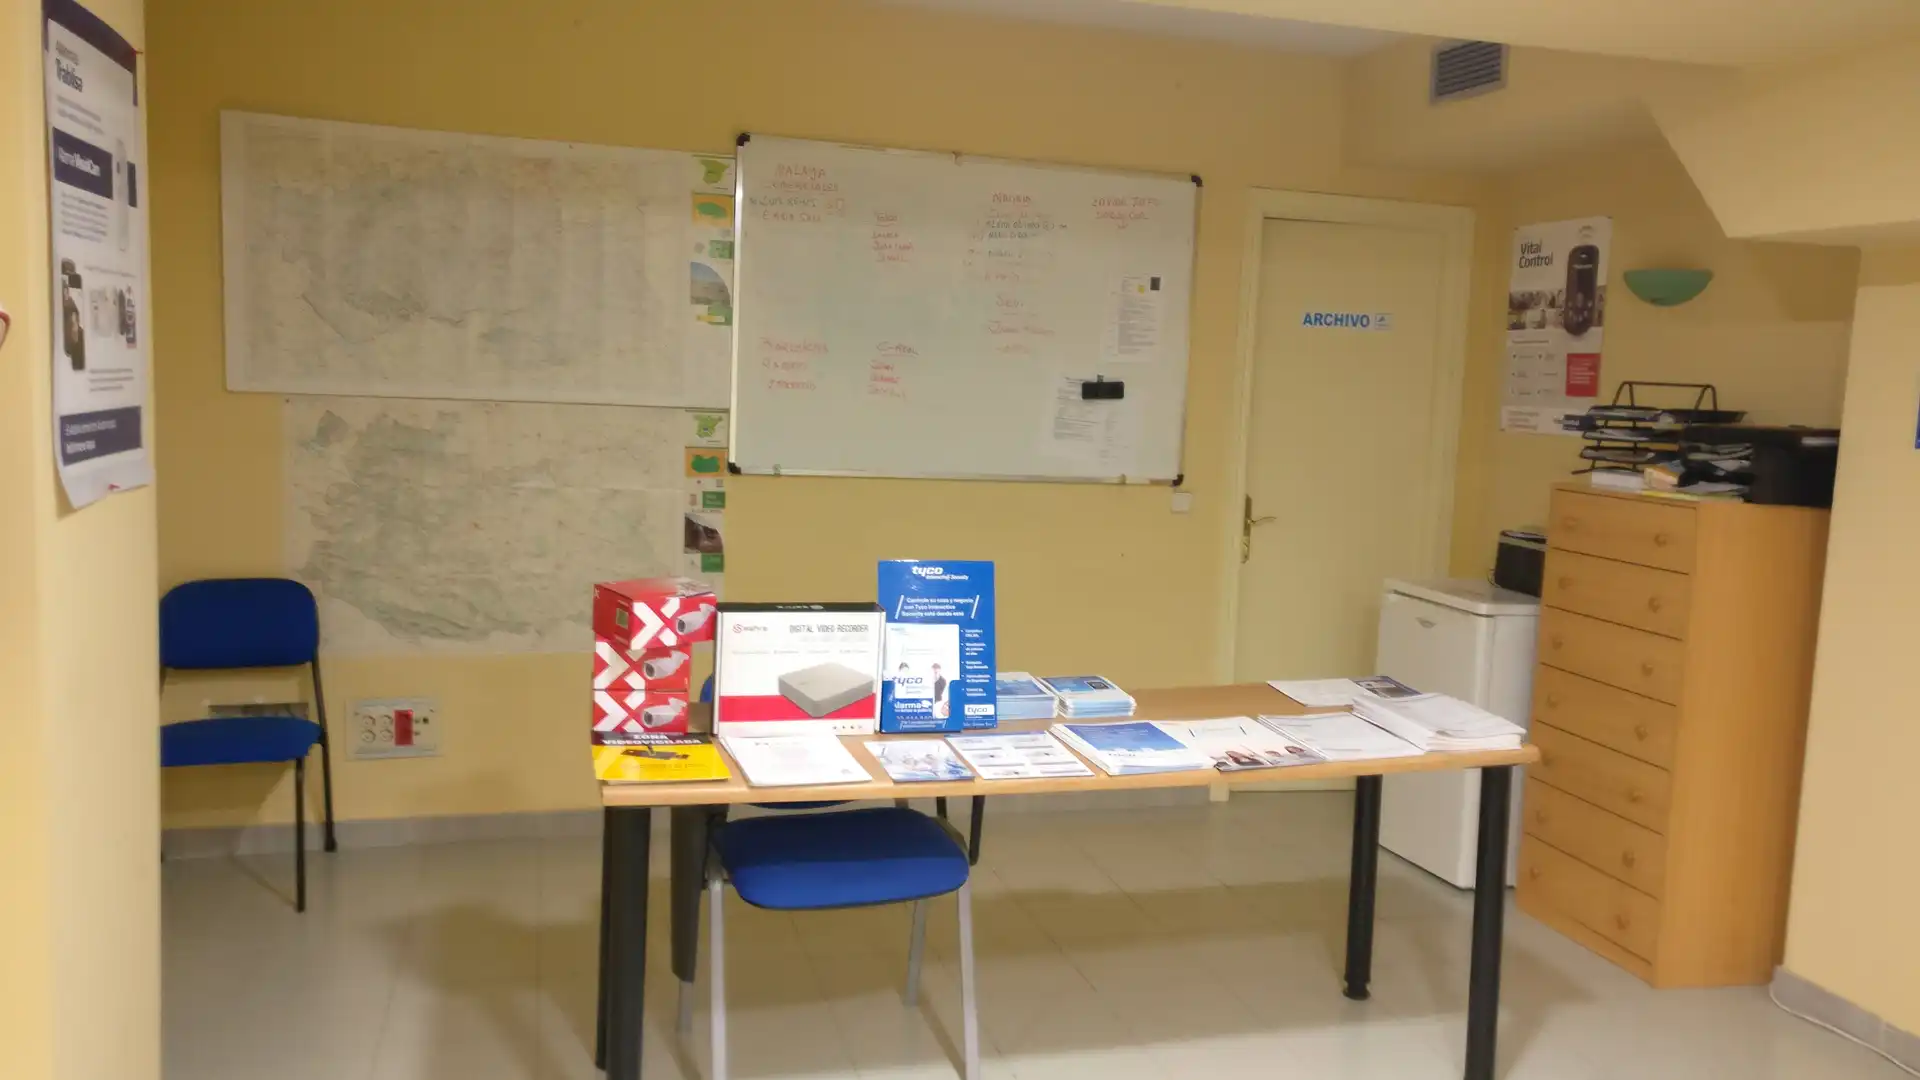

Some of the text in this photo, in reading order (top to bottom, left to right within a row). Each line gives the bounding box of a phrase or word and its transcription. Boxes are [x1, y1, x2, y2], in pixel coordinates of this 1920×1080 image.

[1520, 241, 1543, 256] Vital
[1518, 252, 1554, 269] Control
[1302, 312, 1370, 328] ARCHIVO
[911, 565, 944, 577] tyco
[788, 624, 869, 634] DIGITAL VIDEO RECORDER
[892, 676, 924, 687] tyco
